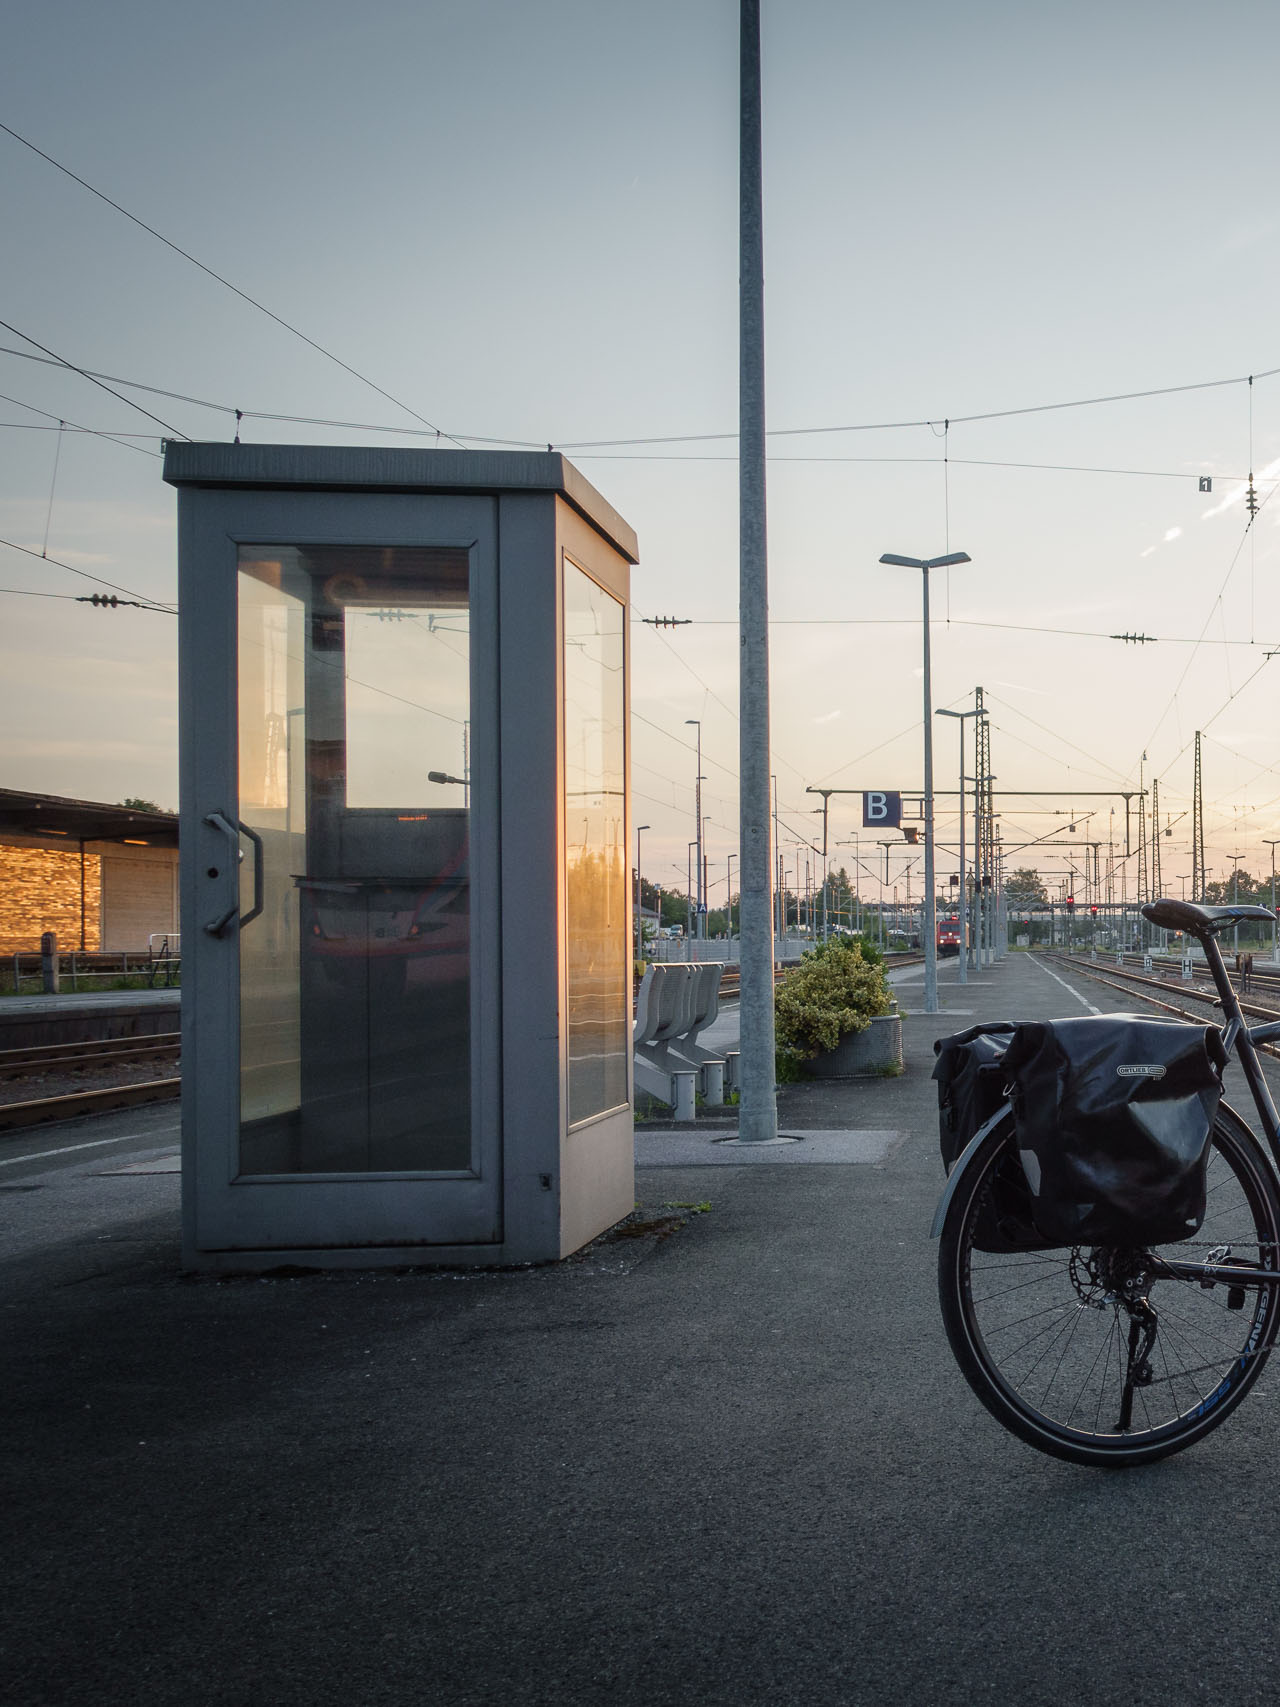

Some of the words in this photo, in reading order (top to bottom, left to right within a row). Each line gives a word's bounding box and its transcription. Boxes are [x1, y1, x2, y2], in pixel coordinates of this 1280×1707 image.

[867, 792, 888, 820] B
[699, 903, 707, 912] A
[1183, 959, 1192, 972] H
